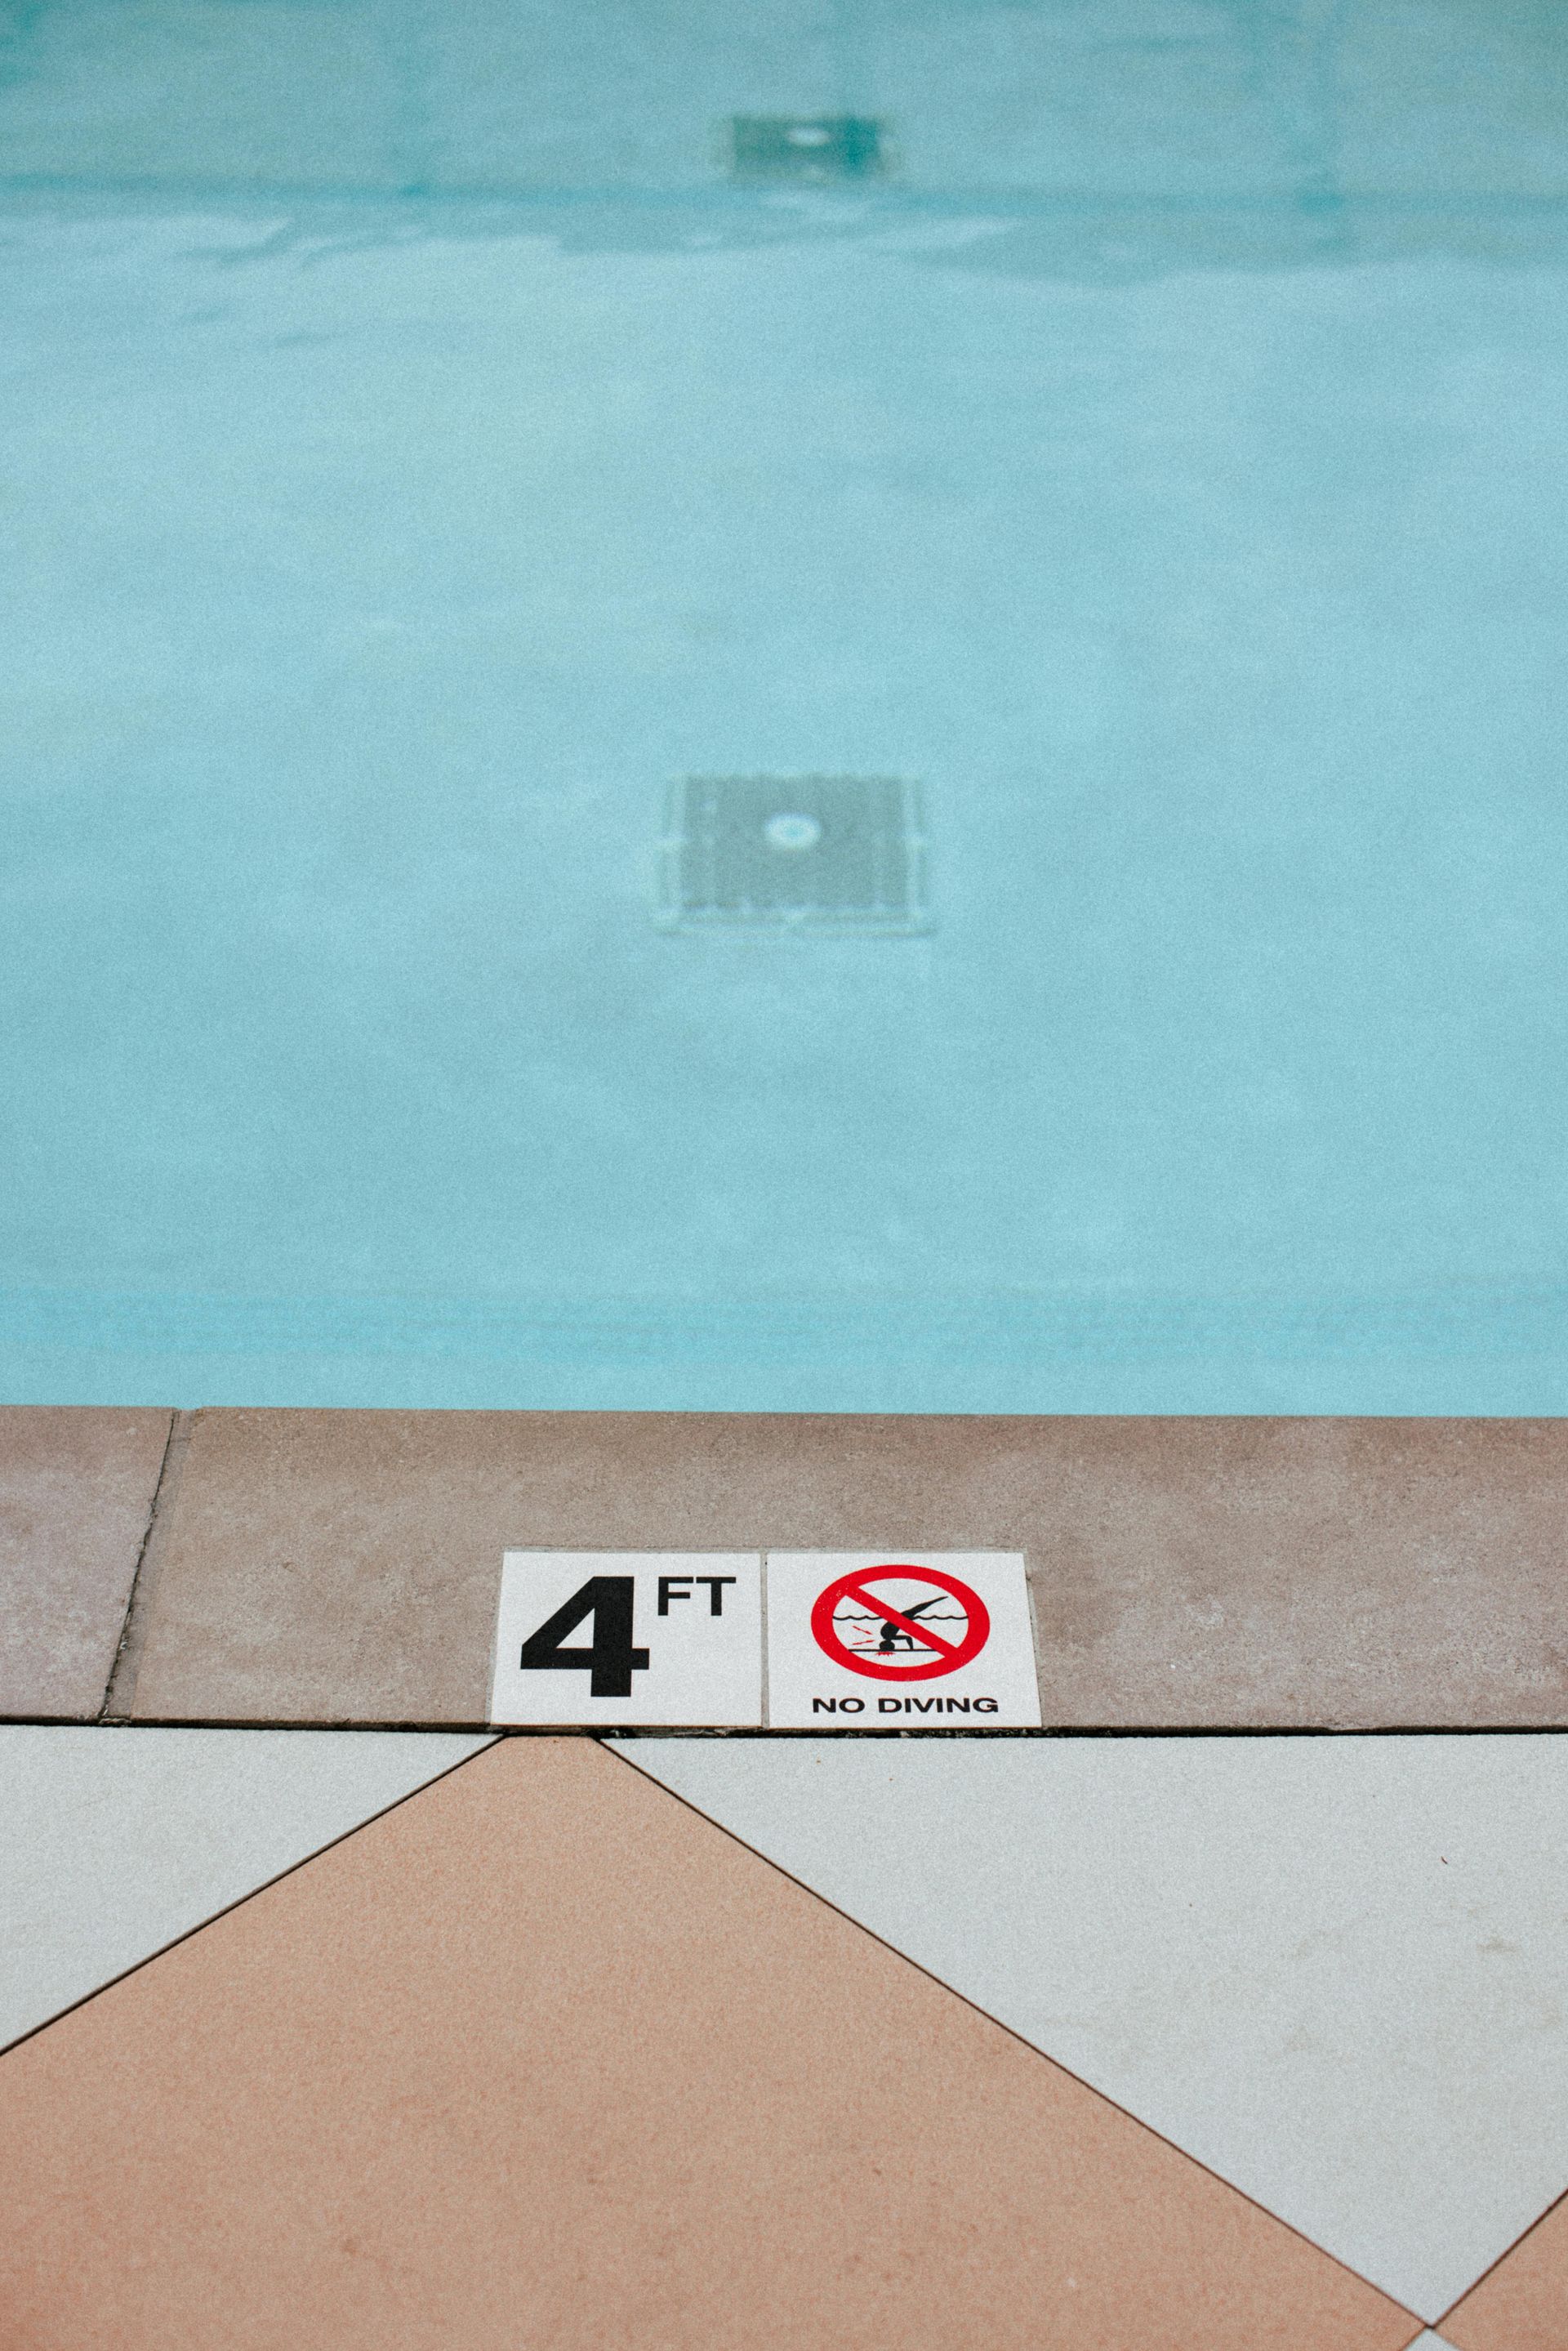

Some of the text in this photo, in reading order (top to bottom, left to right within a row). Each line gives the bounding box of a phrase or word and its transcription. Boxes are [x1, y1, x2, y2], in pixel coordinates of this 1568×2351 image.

[519, 1576, 737, 1697] 4 FT
[812, 1697, 999, 1714] NO DIVING
